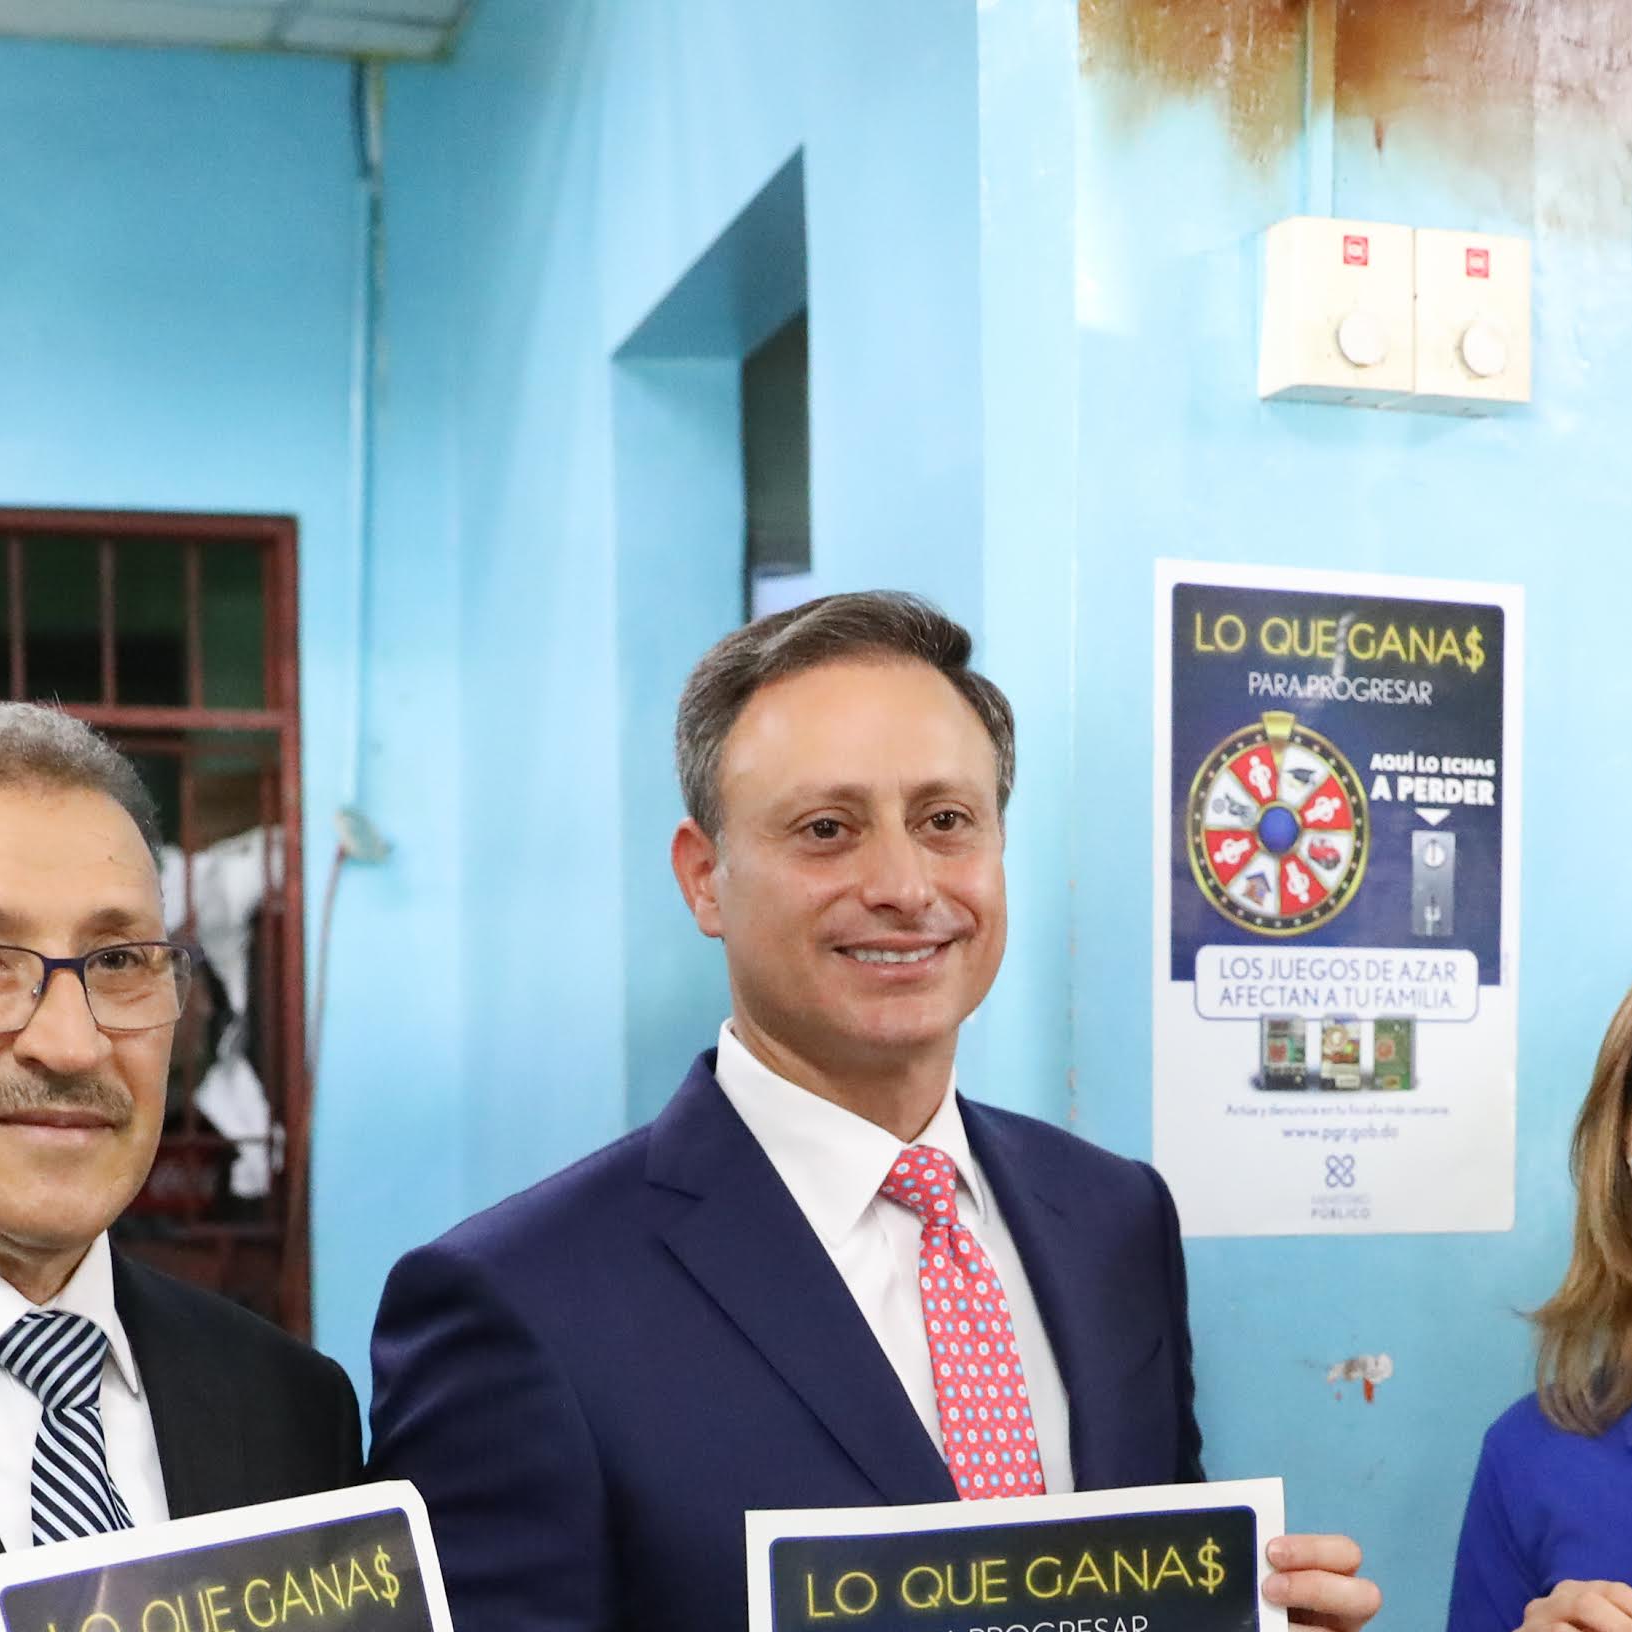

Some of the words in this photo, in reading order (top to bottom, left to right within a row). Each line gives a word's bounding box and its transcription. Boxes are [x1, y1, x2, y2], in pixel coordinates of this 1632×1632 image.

[1195, 612, 1245, 652] LO
[1260, 617, 1338, 658] QUE
[1248, 671, 1304, 698] PARA
[1308, 675, 1432, 705] PROGRESAR
[1370, 774, 1392, 800] A
[1397, 776, 1494, 805] PERDER
[1219, 956, 1264, 980] LOS
[1267, 957, 1361, 981] JUEGOS
[1365, 959, 1394, 982] DE
[1398, 960, 1456, 983] AZAR
[244, 1545, 401, 1630] GANA$
[805, 1569, 877, 1617] LO
[899, 1558, 1008, 1609] QUE
[1025, 1536, 1226, 1600] GANA$
